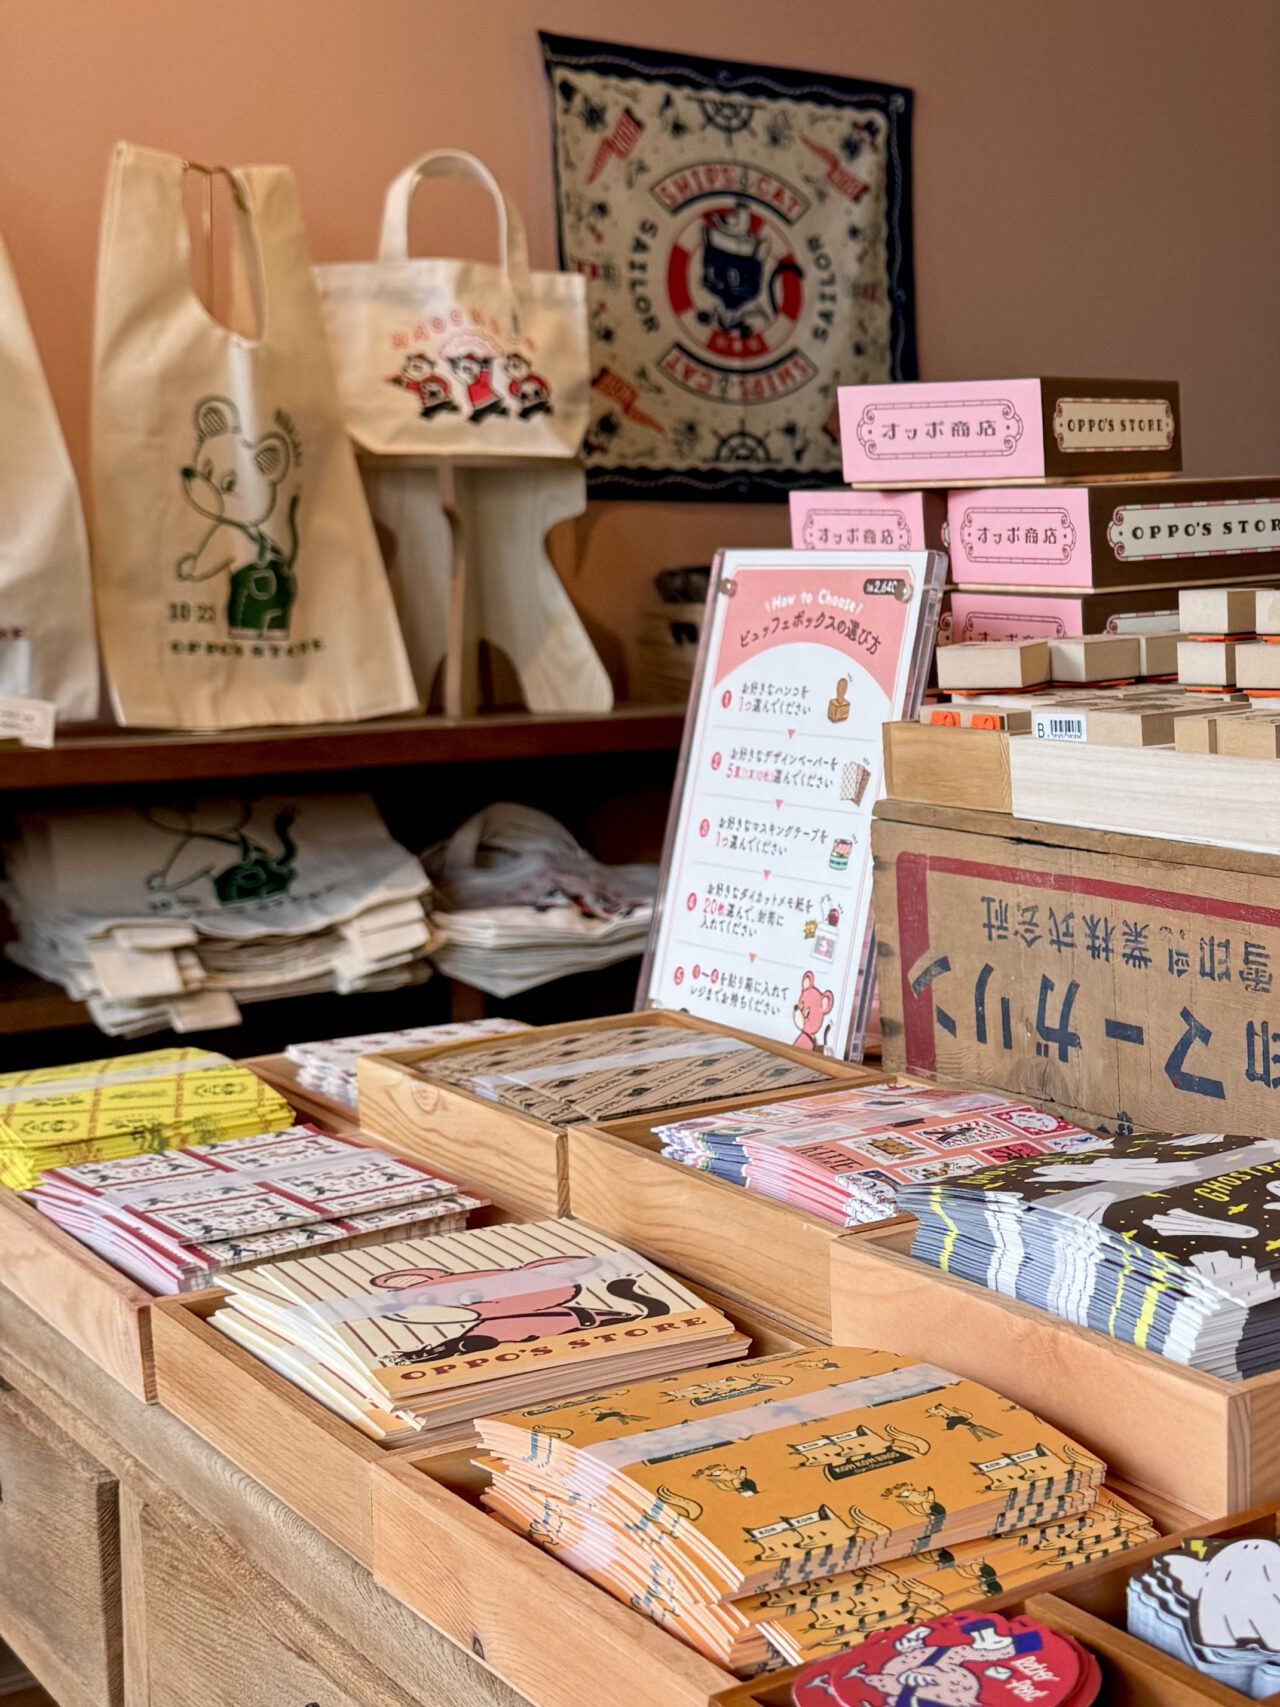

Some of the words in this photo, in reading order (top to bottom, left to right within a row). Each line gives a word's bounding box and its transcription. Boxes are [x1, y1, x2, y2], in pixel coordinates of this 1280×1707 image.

[756, 175, 801, 213] CAT
[627, 219, 661, 334] SAILOR
[881, 420, 997, 441] オッポ商店
[1066, 417, 1116, 433] OPPO'S
[1119, 417, 1164, 433] STORE
[817, 526, 895, 546] オッポ商店
[976, 526, 1058, 546] オッポ商店
[1131, 520, 1213, 541] OPPO'S
[740, 610, 882, 655] ビュッフェボックスの選び方
[1037, 722, 1046, 739] B
[979, 895, 1273, 994] 雪印乳業株式会社
[400, 1345, 553, 1381] OPPO'S
[567, 1316, 708, 1350] STORE
